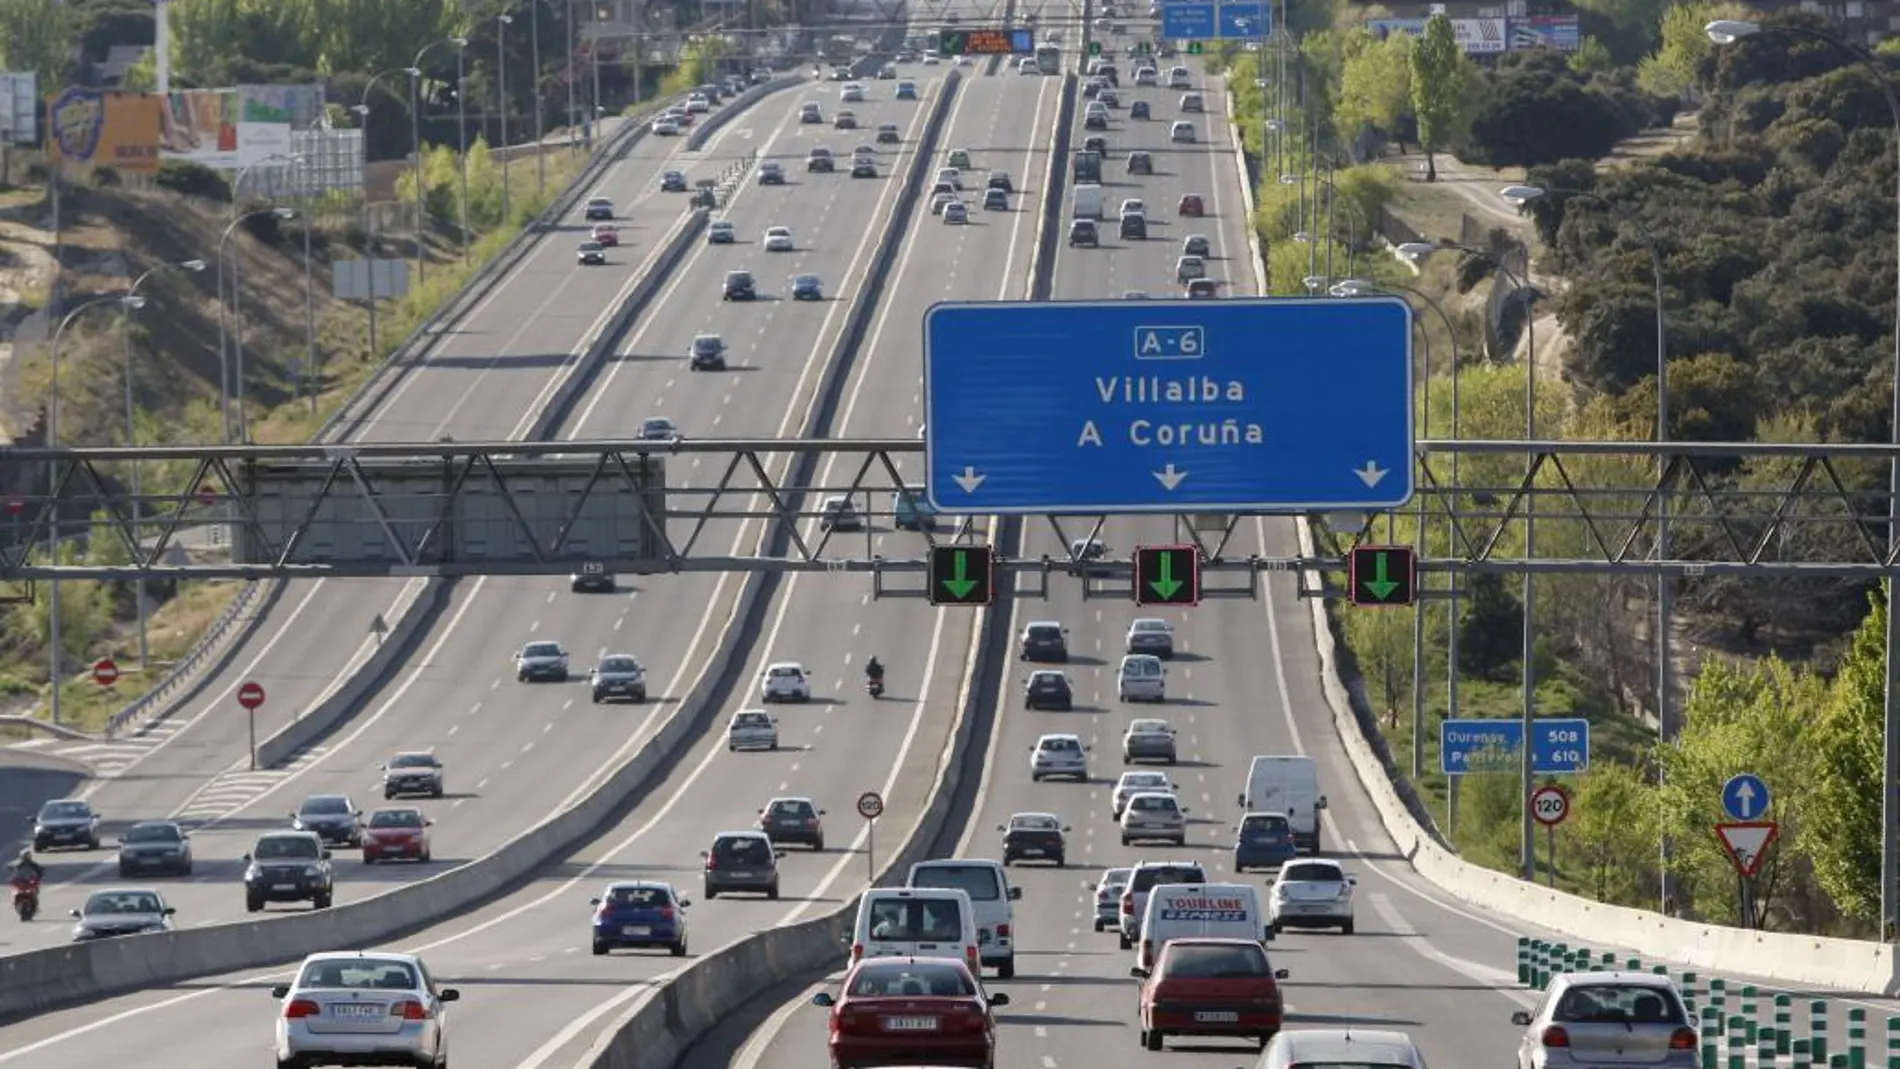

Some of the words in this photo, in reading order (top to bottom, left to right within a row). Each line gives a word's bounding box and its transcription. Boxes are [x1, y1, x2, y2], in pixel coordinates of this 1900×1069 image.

[1141, 331, 1198, 353] A-6
[1095, 376, 1245, 403] Villalba
[1077, 420, 1103, 448] A
[1129, 418, 1264, 446] Coruña
[1547, 730, 1579, 743] 508
[1551, 750, 1580, 763] 610
[861, 800, 880, 810] 120
[1537, 799, 1563, 812] 120
[1164, 898, 1243, 909] TOURLINE
